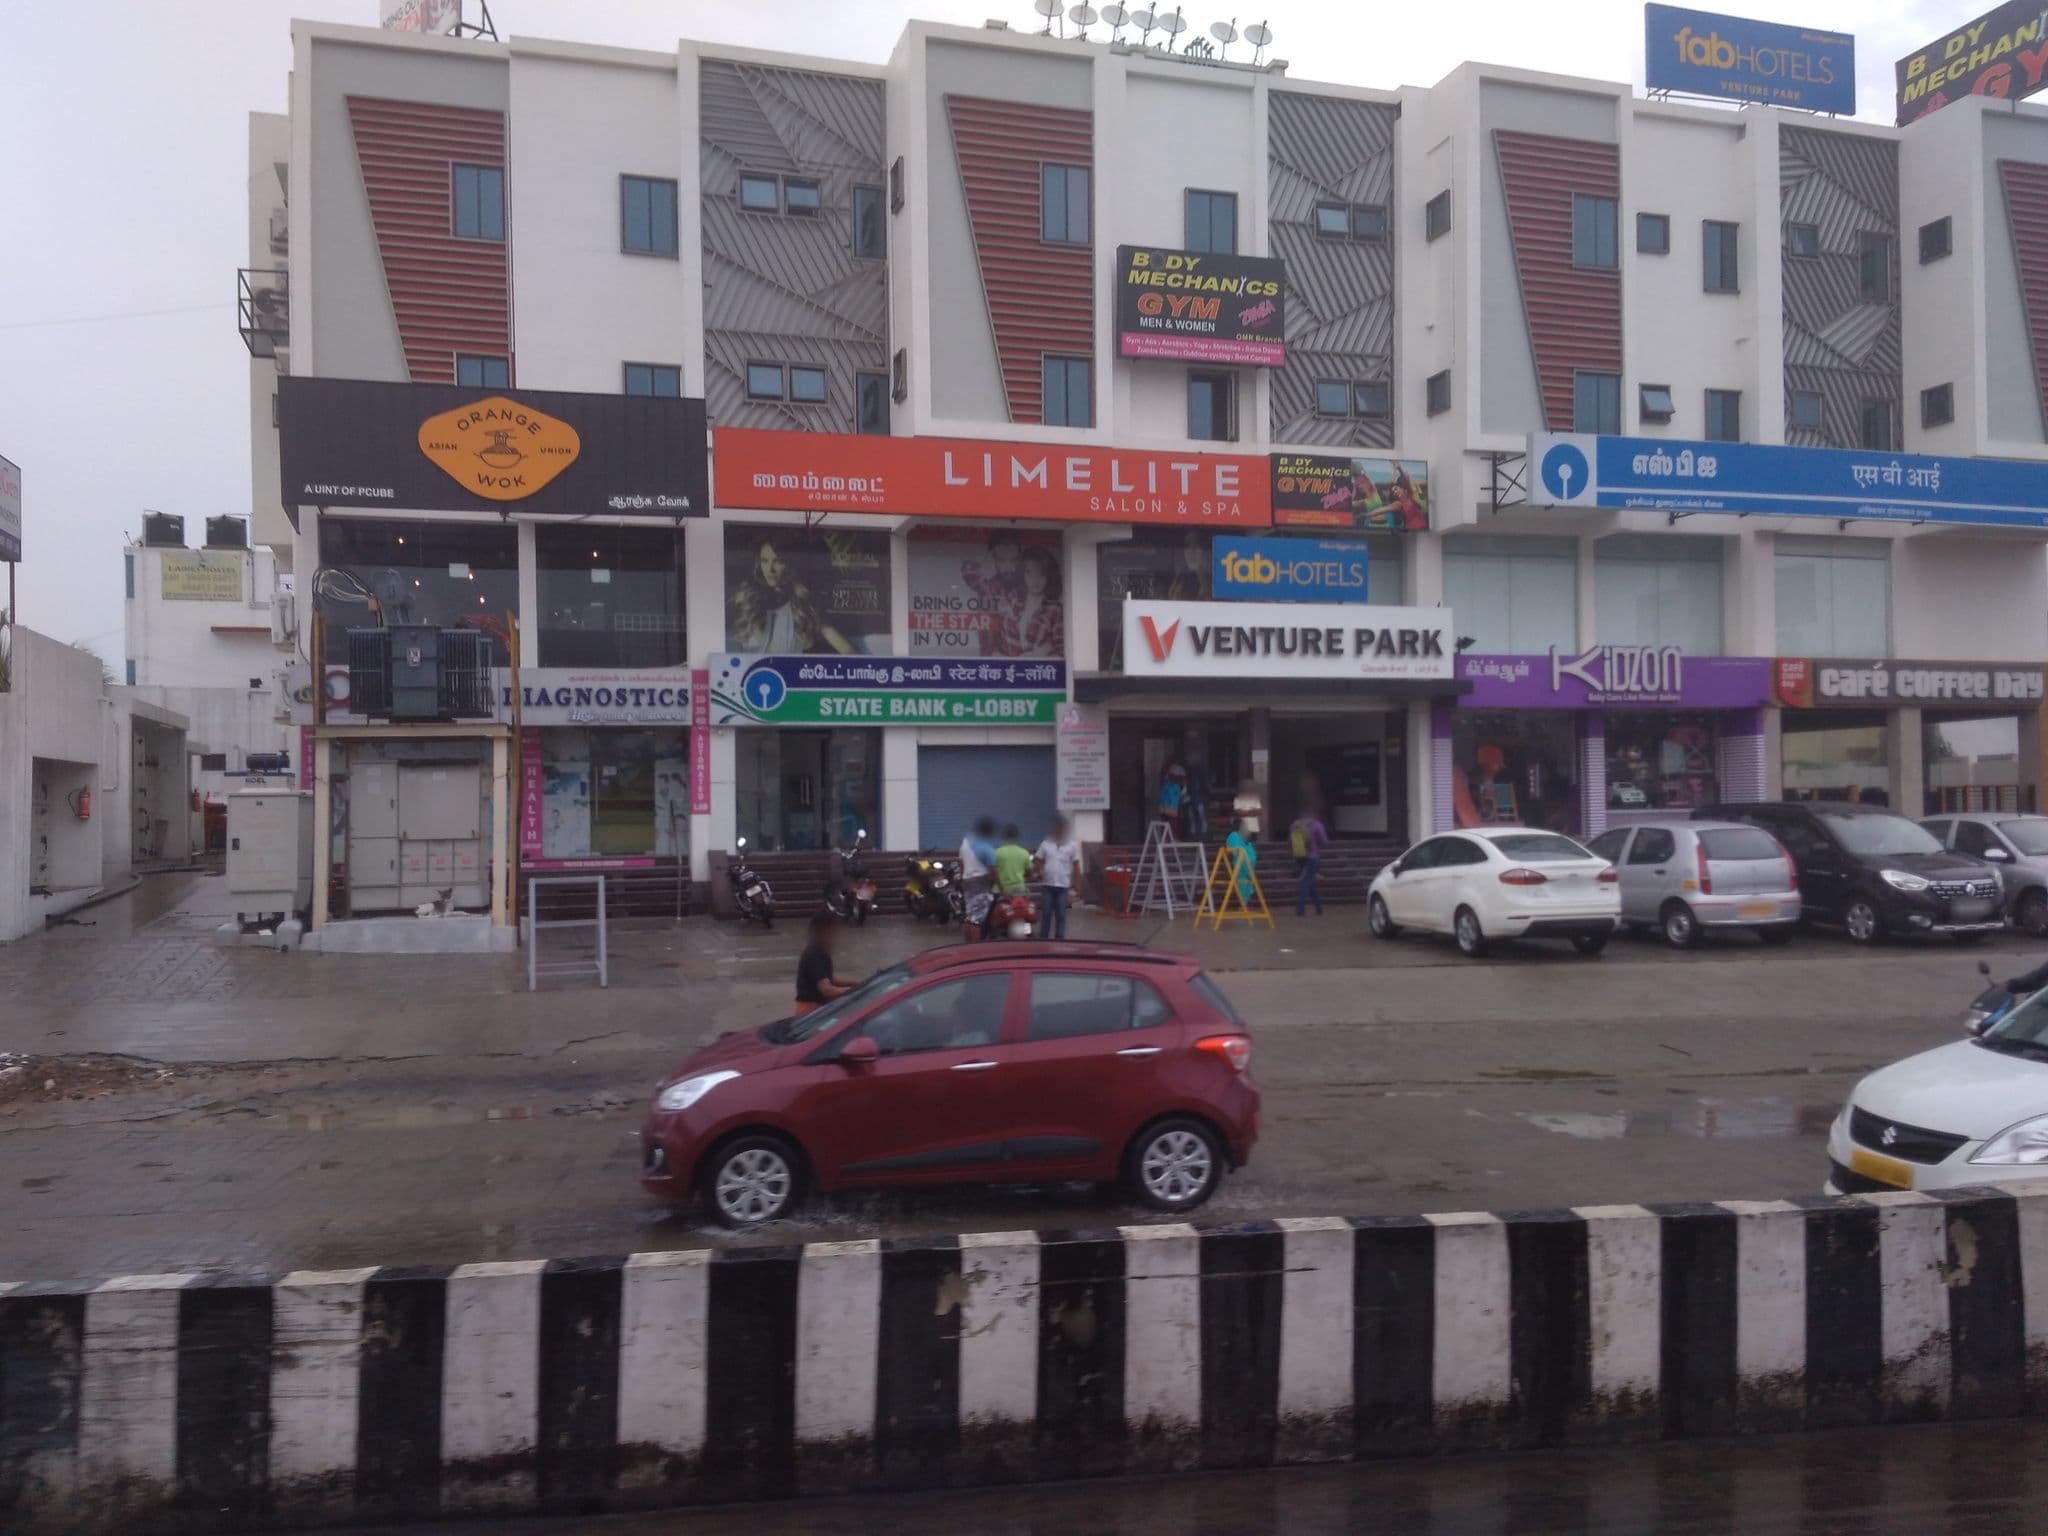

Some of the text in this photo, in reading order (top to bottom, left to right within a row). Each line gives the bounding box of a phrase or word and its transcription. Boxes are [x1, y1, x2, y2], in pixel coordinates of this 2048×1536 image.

[1674, 26, 1834, 85] fabHOTELS
[1137, 292, 1221, 321] GYM
[1139, 317, 1216, 332] MEN & WOMEN
[457, 408, 542, 435] ORANGE
[428, 442, 571, 455] ASIAN UNION
[1633, 447, 1717, 478] எஸ் பி ஐ
[477, 472, 526, 489] WOK
[944, 451, 1239, 497] LIMELITE
[1851, 460, 1940, 493] एस बी आई
[304, 484, 313, 493] A
[341, 486, 355, 496] OF
[1277, 476, 1333, 494] GYM
[1090, 497, 1240, 516] SALON & SPA
[1221, 551, 1364, 587] fabHOTELS
[914, 596, 1001, 611] BRING OUT
[915, 614, 990, 631] THE STAR
[914, 631, 969, 647] IN YOU
[1188, 626, 1344, 657] VENTURE
[1354, 628, 1443, 658] PARK
[799, 664, 845, 681] ஸ்டேட்
[819, 698, 1039, 717] STATE BANK e-LOBBY
[527, 767, 537, 840] HEALTH
